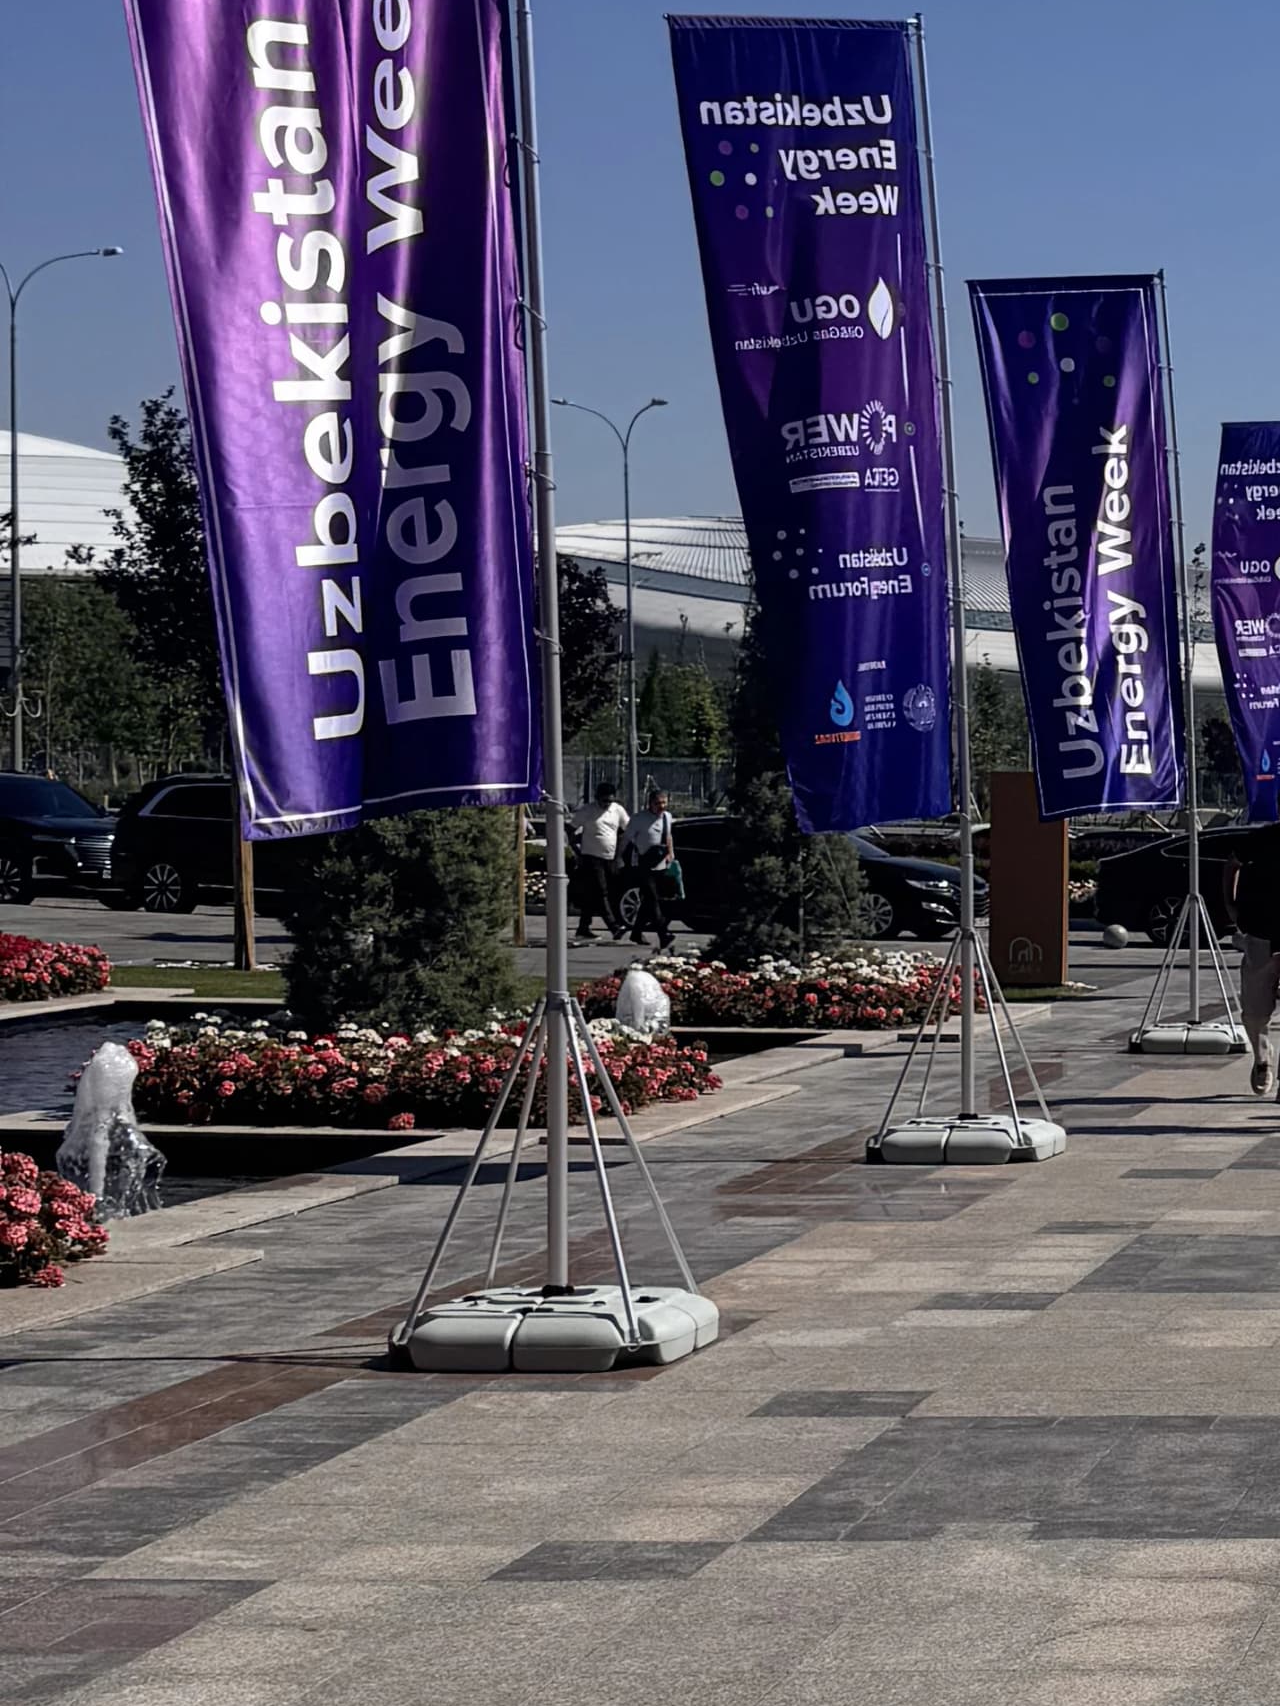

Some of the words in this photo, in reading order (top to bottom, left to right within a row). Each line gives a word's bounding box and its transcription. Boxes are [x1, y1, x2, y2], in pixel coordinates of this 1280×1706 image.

[247, 16, 365, 743] Uzbekistan
[372, 291, 477, 727] Energy
[1091, 423, 1133, 576] Week
[1043, 484, 1104, 779] Uzbekistan
[1106, 590, 1153, 775] Energy
